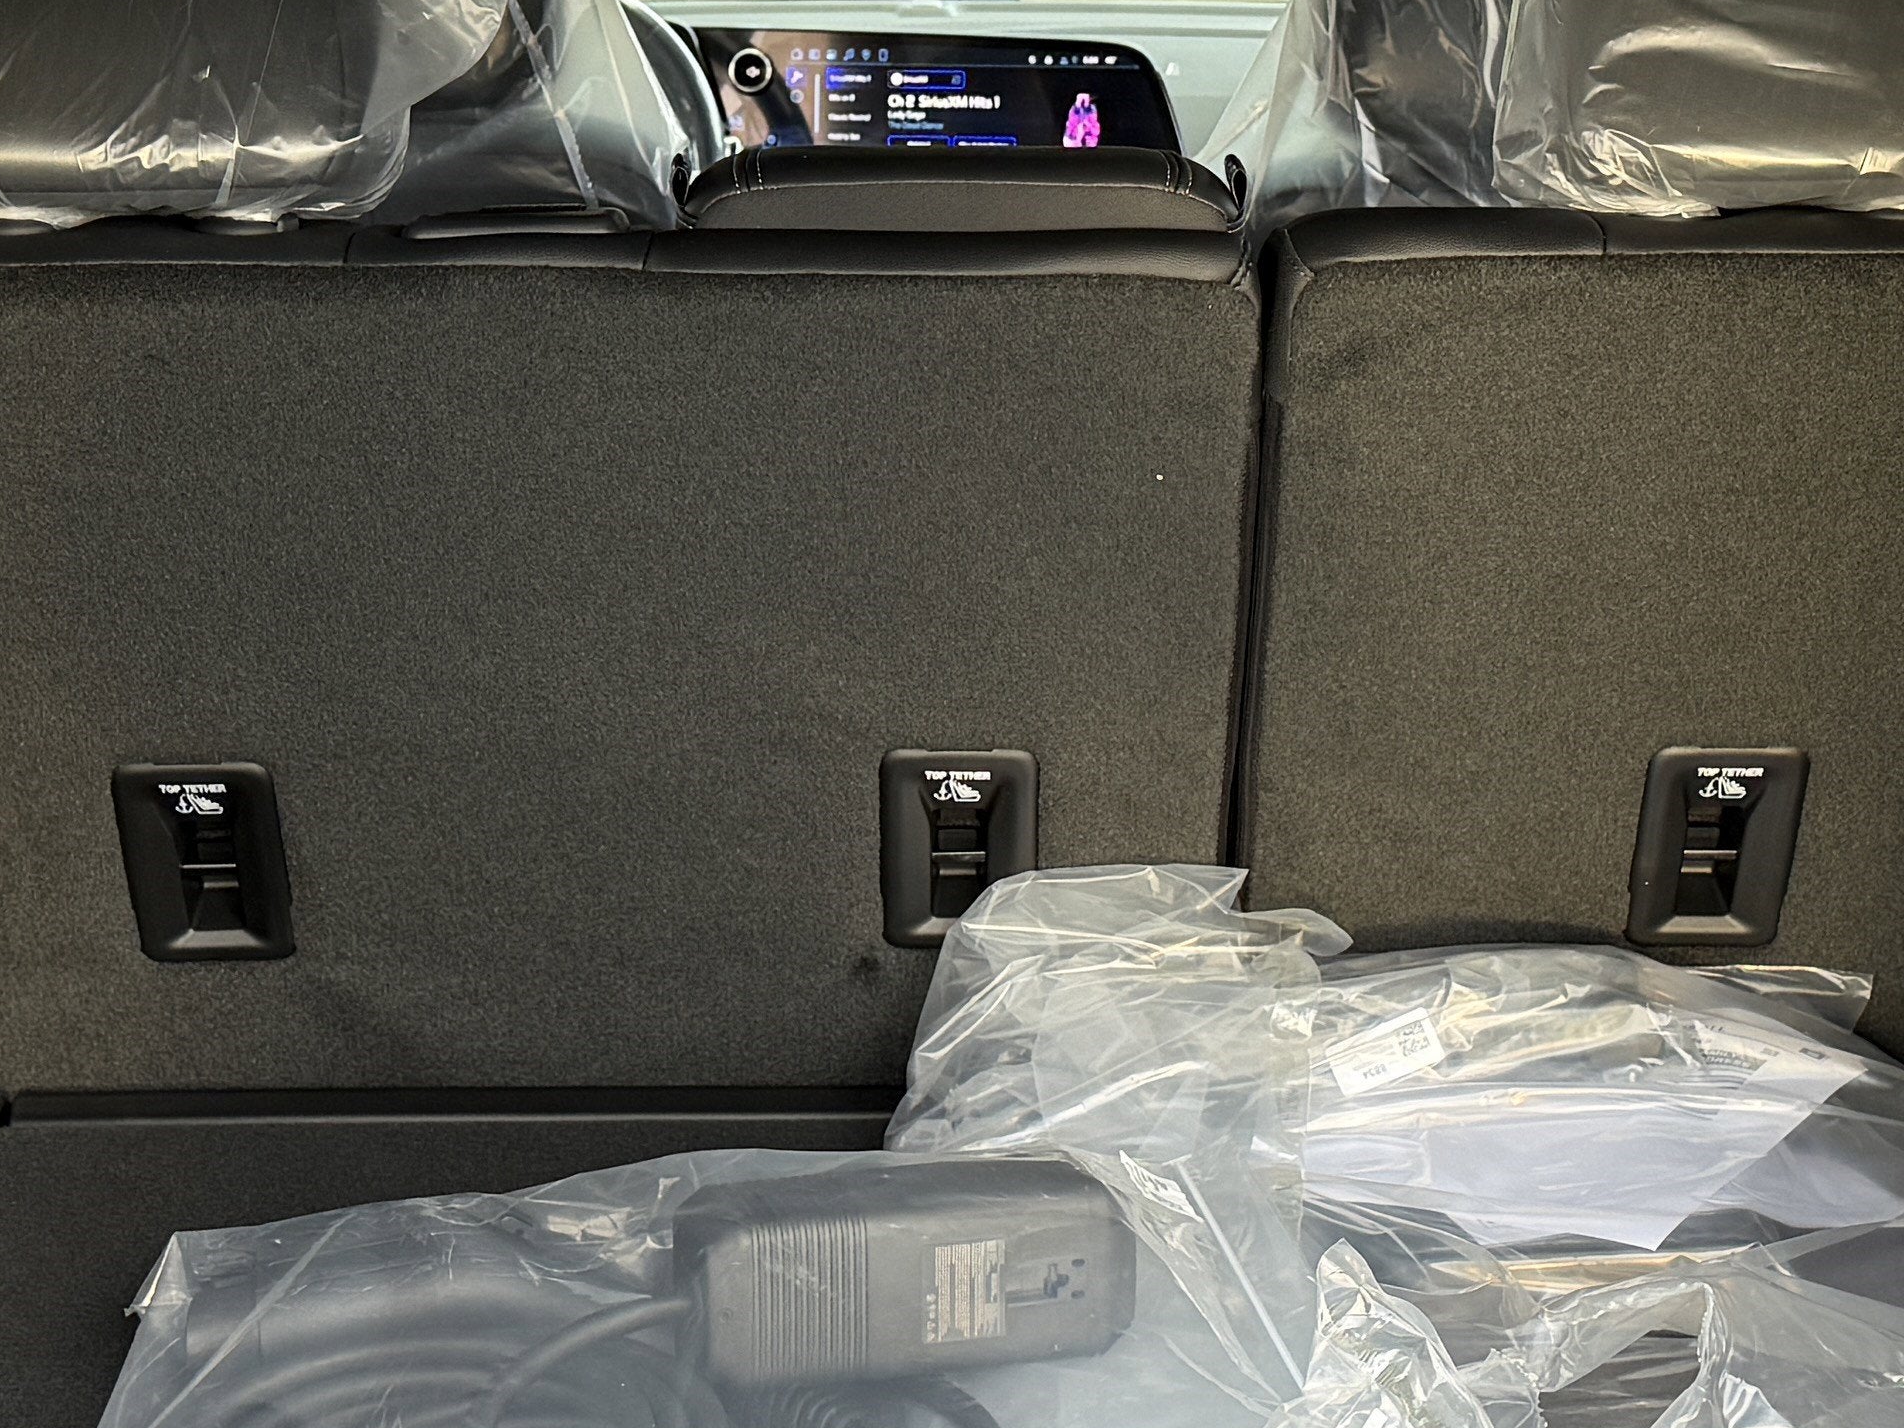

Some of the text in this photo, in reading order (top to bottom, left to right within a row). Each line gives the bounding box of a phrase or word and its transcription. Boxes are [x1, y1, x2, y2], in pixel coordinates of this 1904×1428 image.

[924, 770, 991, 781] TOP TETHER
[1697, 767, 1765, 778] TOP TETHER
[158, 783, 227, 794] TOP TETHER
